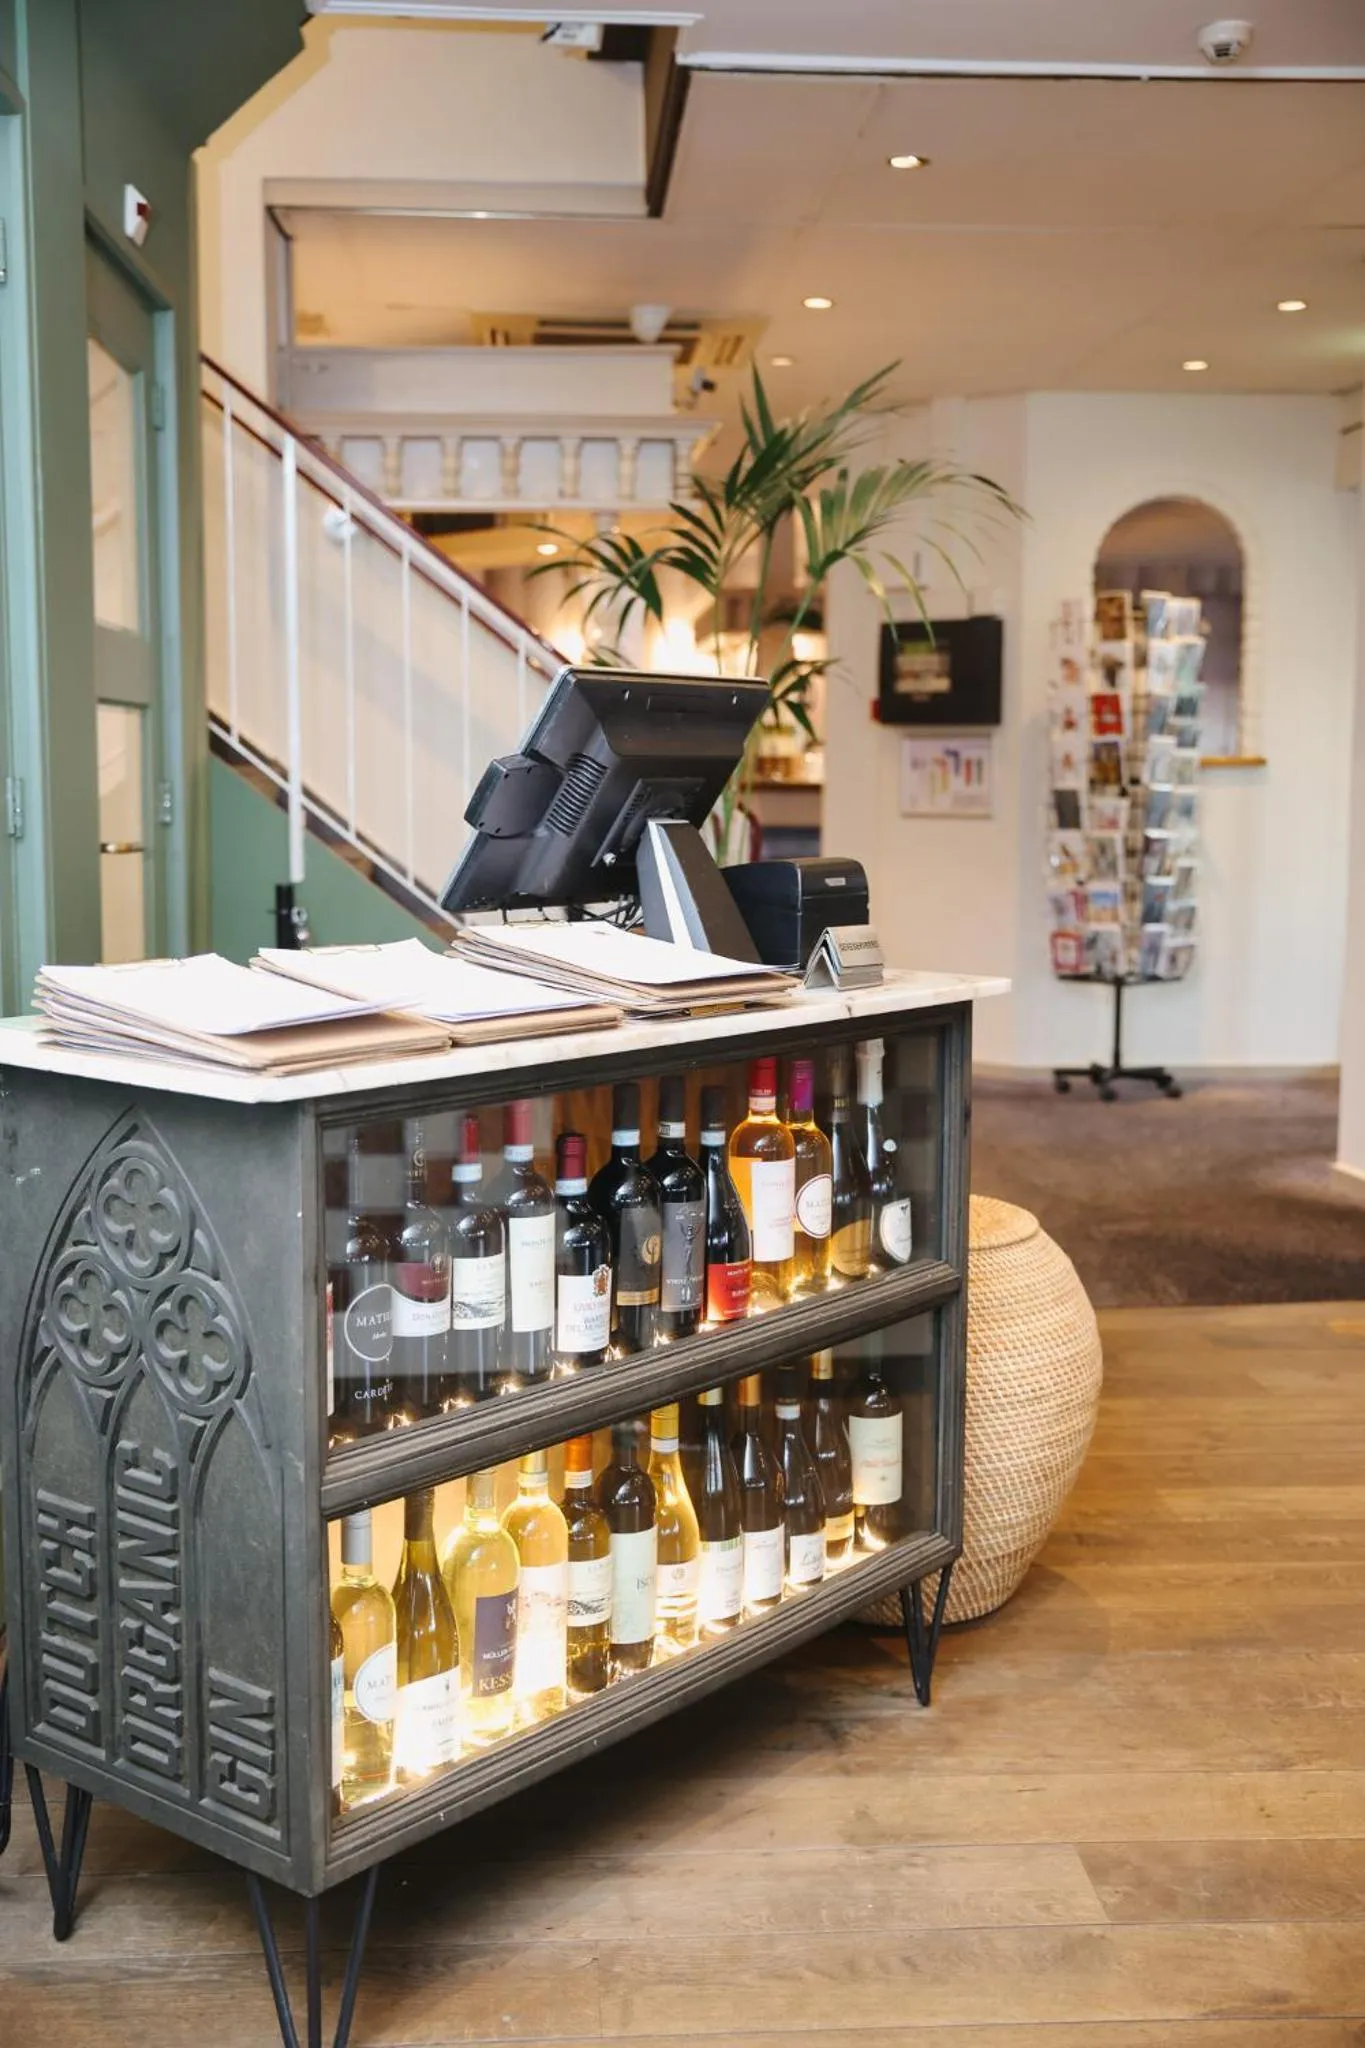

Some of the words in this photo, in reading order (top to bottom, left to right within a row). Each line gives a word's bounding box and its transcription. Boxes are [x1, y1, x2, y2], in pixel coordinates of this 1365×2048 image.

[37, 1487, 99, 1742] DUTCH
[115, 1439, 179, 1778] ORGANIC
[208, 1666, 275, 1820] GIN
